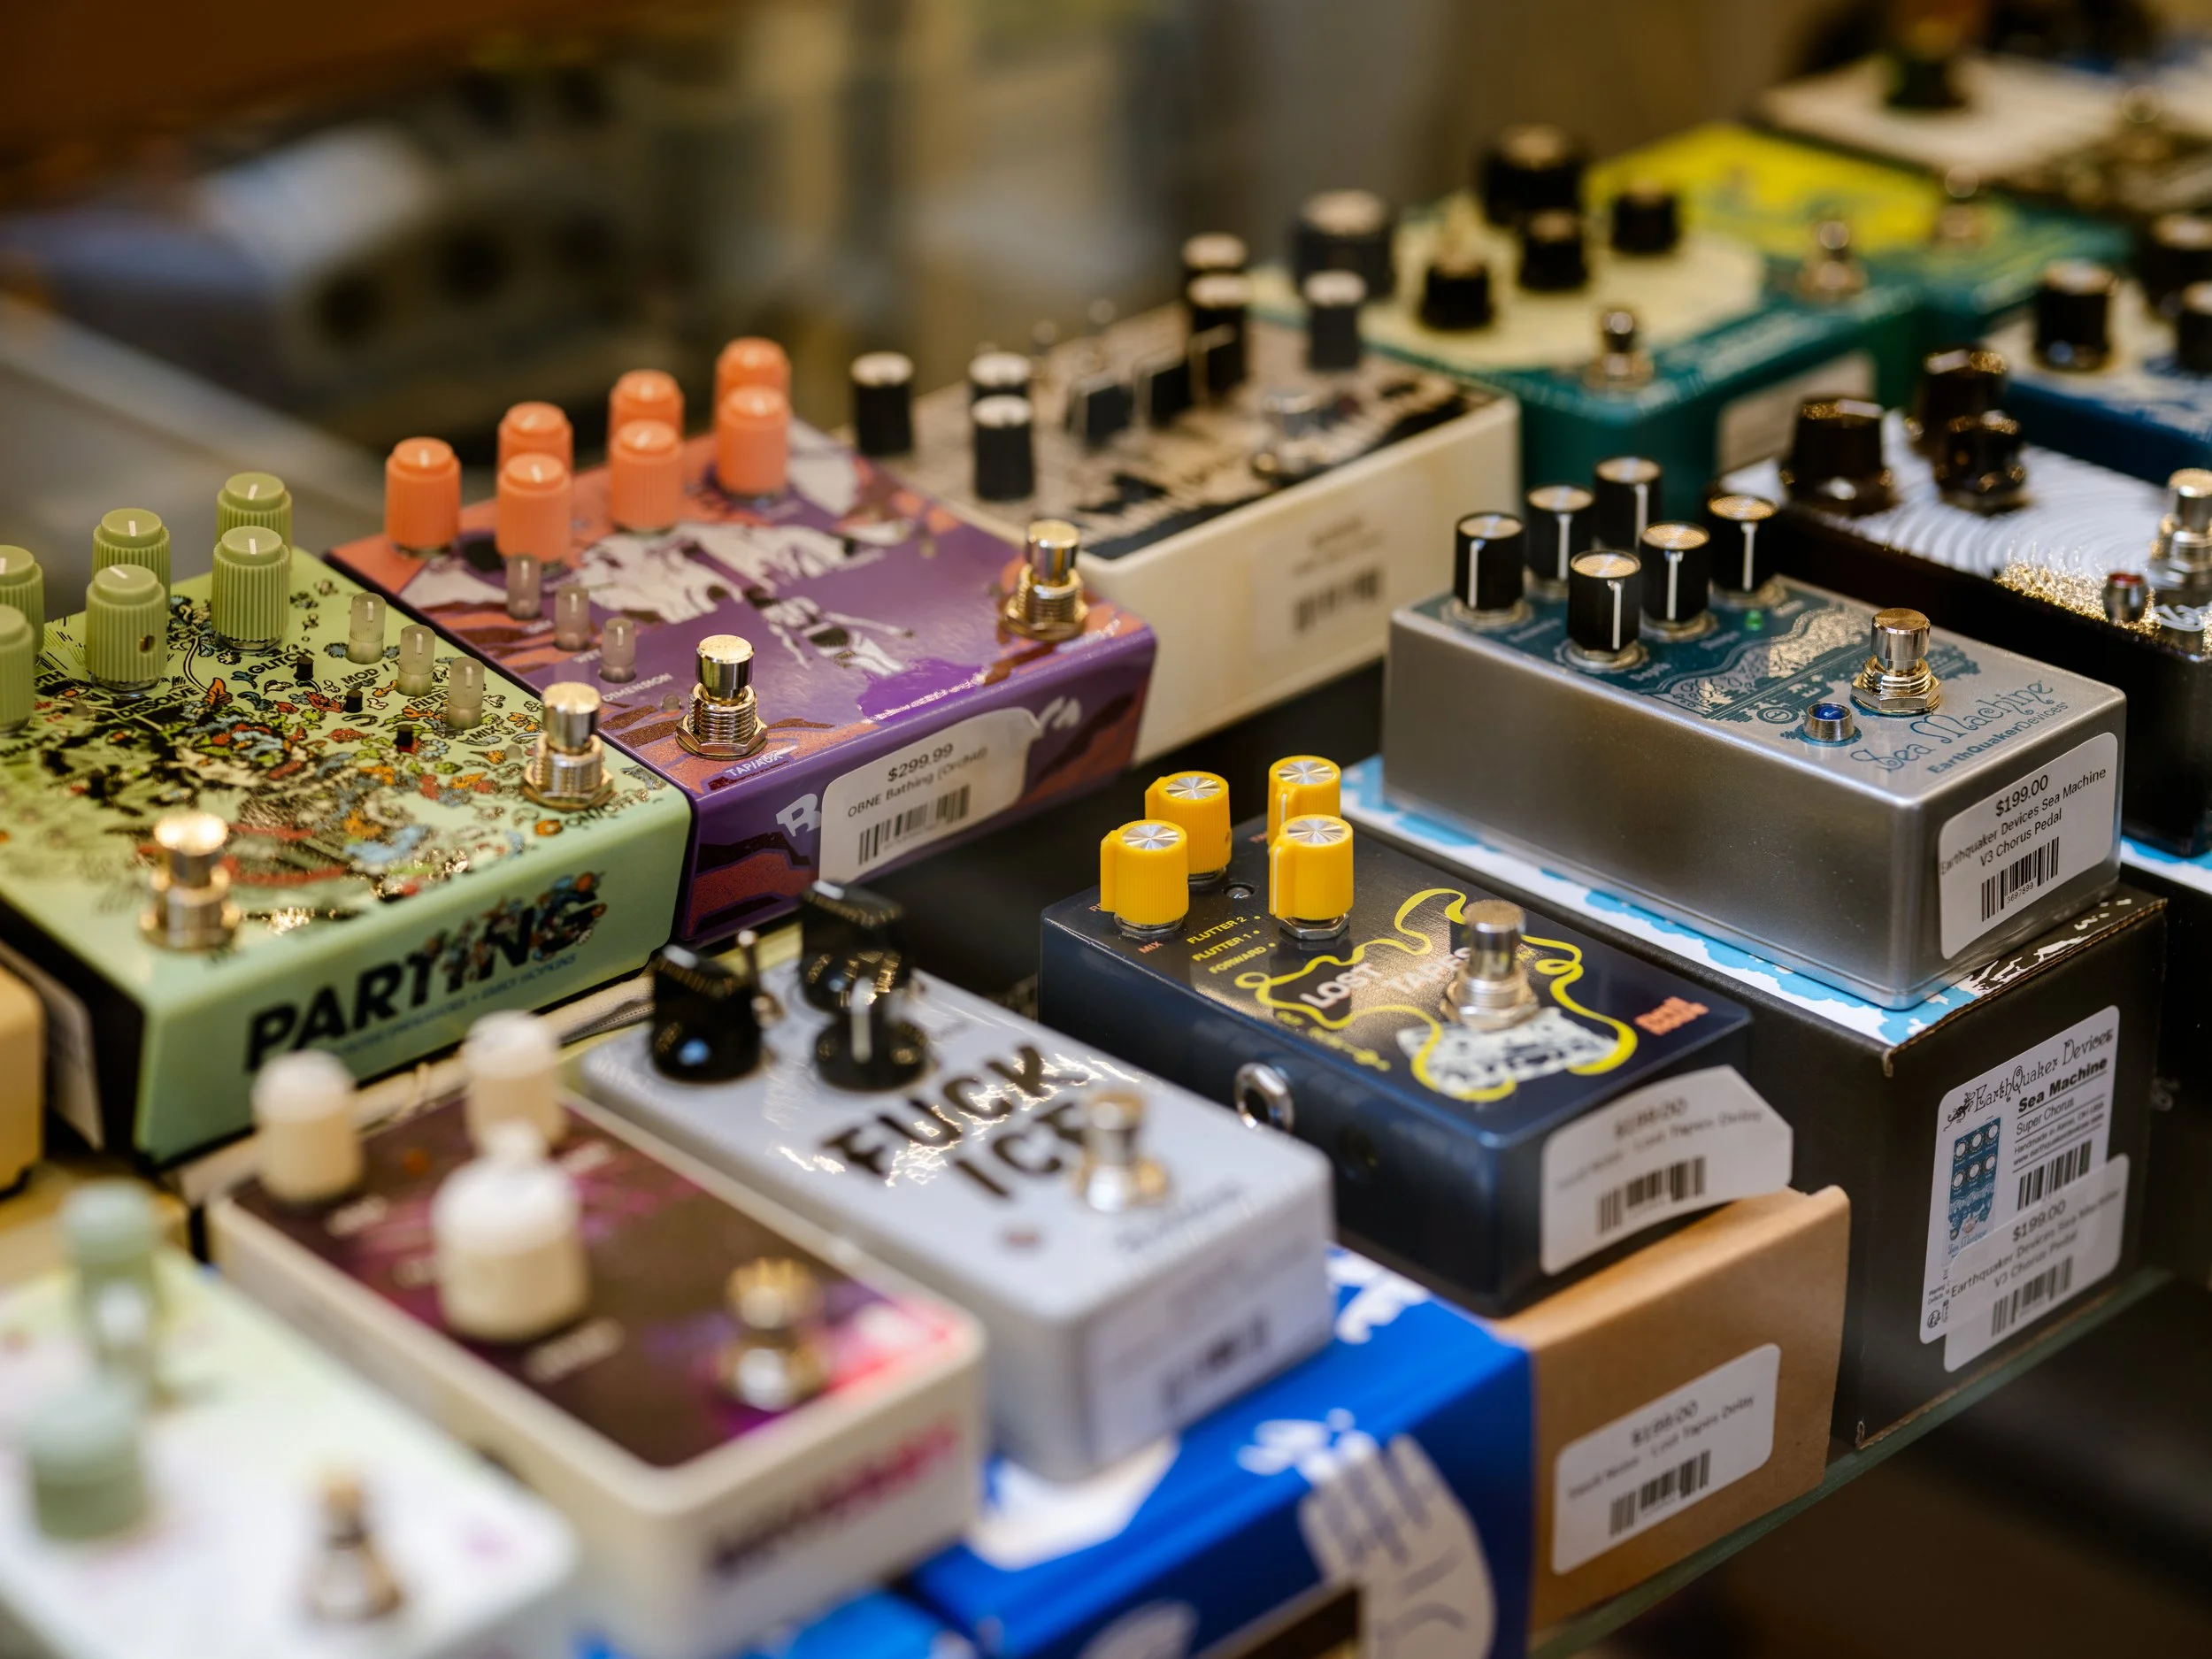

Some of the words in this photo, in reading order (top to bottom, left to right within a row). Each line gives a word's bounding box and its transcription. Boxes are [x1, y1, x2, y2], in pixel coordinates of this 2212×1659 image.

[340, 668, 379, 686] MOD
[602, 672, 674, 703] DIMENSION
[118, 687, 201, 718] DISSOLVE
[472, 726, 501, 741] MIX
[1849, 742, 1936, 773] Sea
[1909, 680, 2054, 744] Machine
[1926, 702, 2069, 774] EarthQuakerDevices
[725, 749, 784, 778] TAP/AUX
[887, 742, 955, 783] $299.99
[848, 793, 881, 818] OBNE
[886, 772, 935, 801] Bathing
[1995, 774, 2049, 818] $199.00
[1939, 829, 1999, 876] Earthquaker
[2001, 806, 2039, 836] Devices
[2041, 794, 2061, 811] Sea
[2062, 768, 2107, 800] Machine
[1979, 850, 1994, 867] V3
[1995, 828, 2032, 857] Chorus
[2034, 808, 2062, 836] Pedal
[2006, 882, 2035, 904] 3697899
[1138, 941, 1164, 955] MIX
[1186, 920, 1238, 945] FLUTTER
[1238, 916, 1248, 926] 2
[1192, 935, 1242, 963] FLUTTER
[244, 872, 609, 1072] PARTING
[1208, 946, 1267, 974] FORWARD
[1299, 962, 1383, 1010] LOST
[1974, 1064, 2058, 1113] EarthQuaker
[2062, 1028, 2114, 1066] Devices
[2018, 1090, 2045, 1113] Sea
[2049, 1057, 2108, 1098] Machine
[819, 1044, 1090, 1177] FUCK
[2016, 1113, 2043, 1136] Super
[2044, 1097, 2075, 1121] Chorus
[2012, 1198, 2067, 1242] $199.00
[1950, 1252, 2014, 1298] Earthquaker
